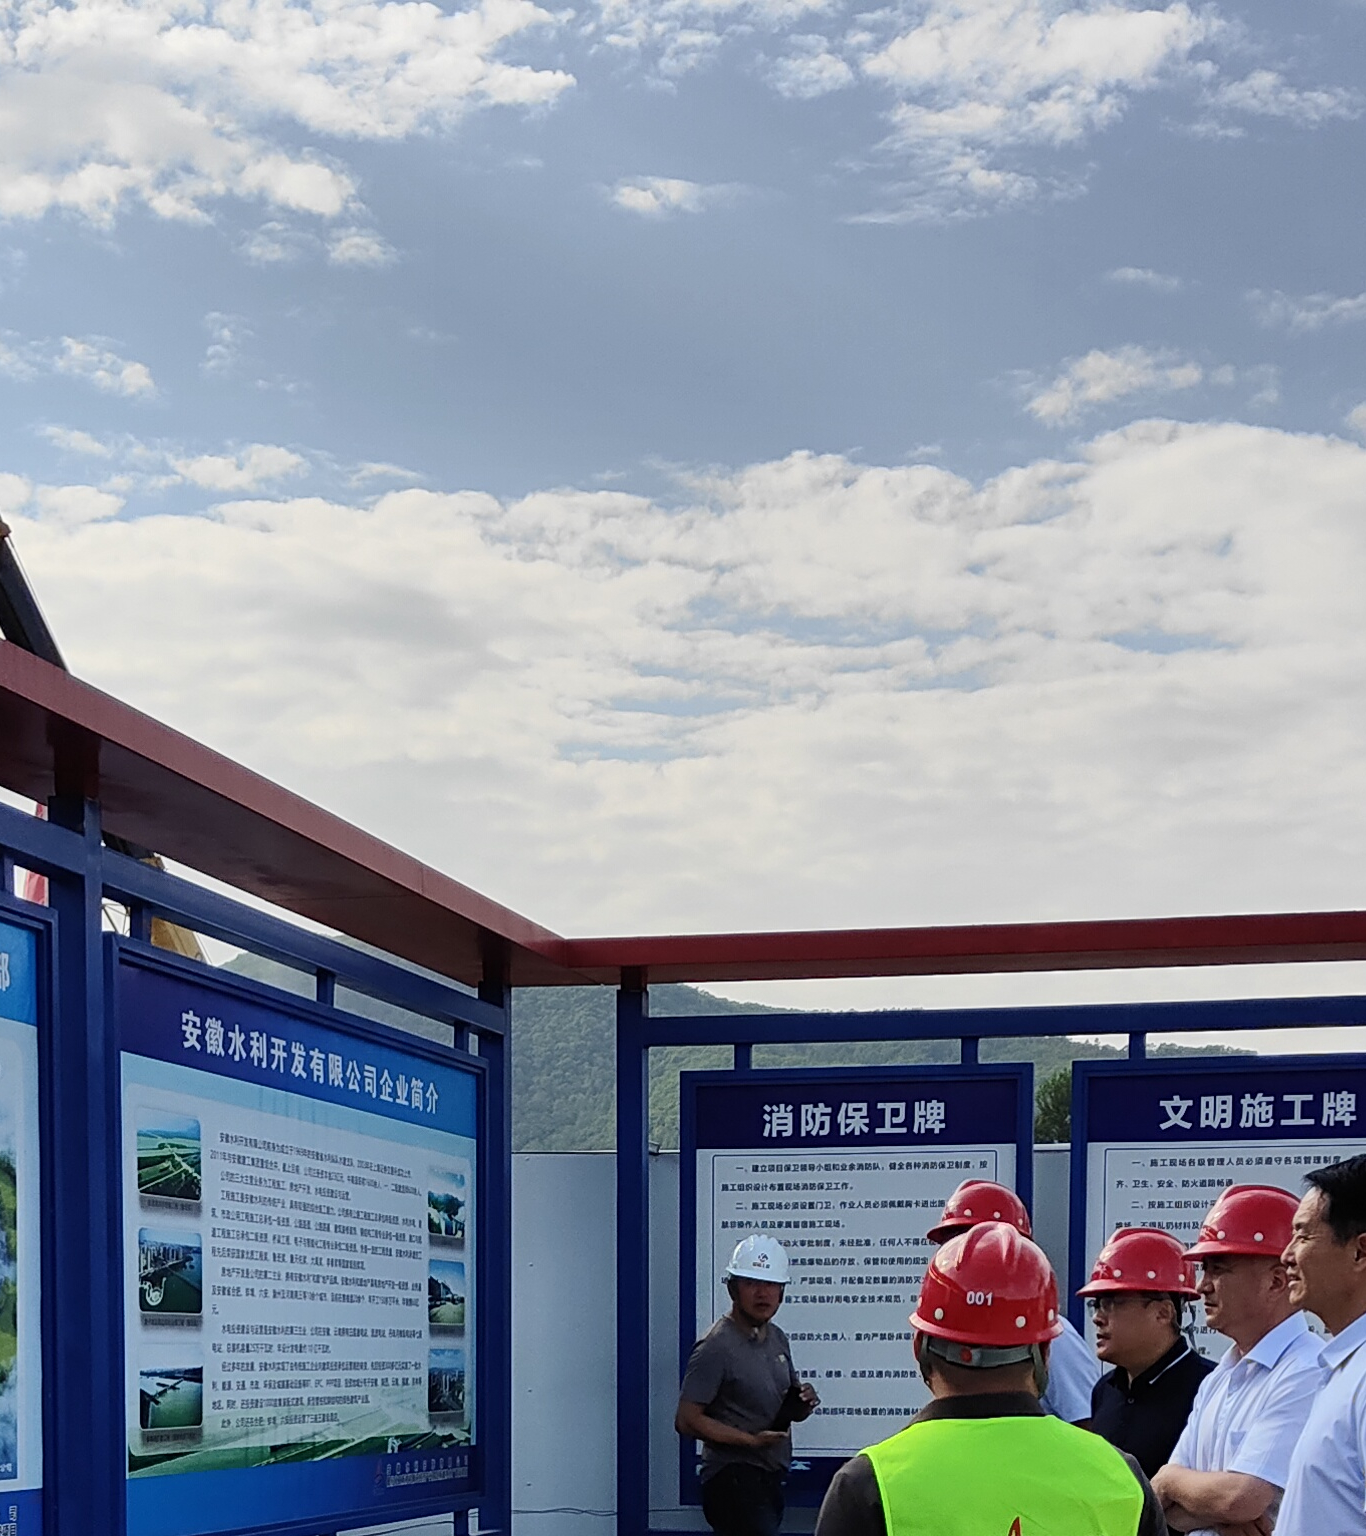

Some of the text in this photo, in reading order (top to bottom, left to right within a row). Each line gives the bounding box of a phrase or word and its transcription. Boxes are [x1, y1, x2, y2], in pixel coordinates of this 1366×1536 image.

[180, 1009, 439, 1115] 安徽水利开发有限公司企业简介
[761, 1099, 947, 1138] 消防保卫牌
[1158, 1090, 1358, 1131] 文明施工牌
[966, 1290, 994, 1306] 001
